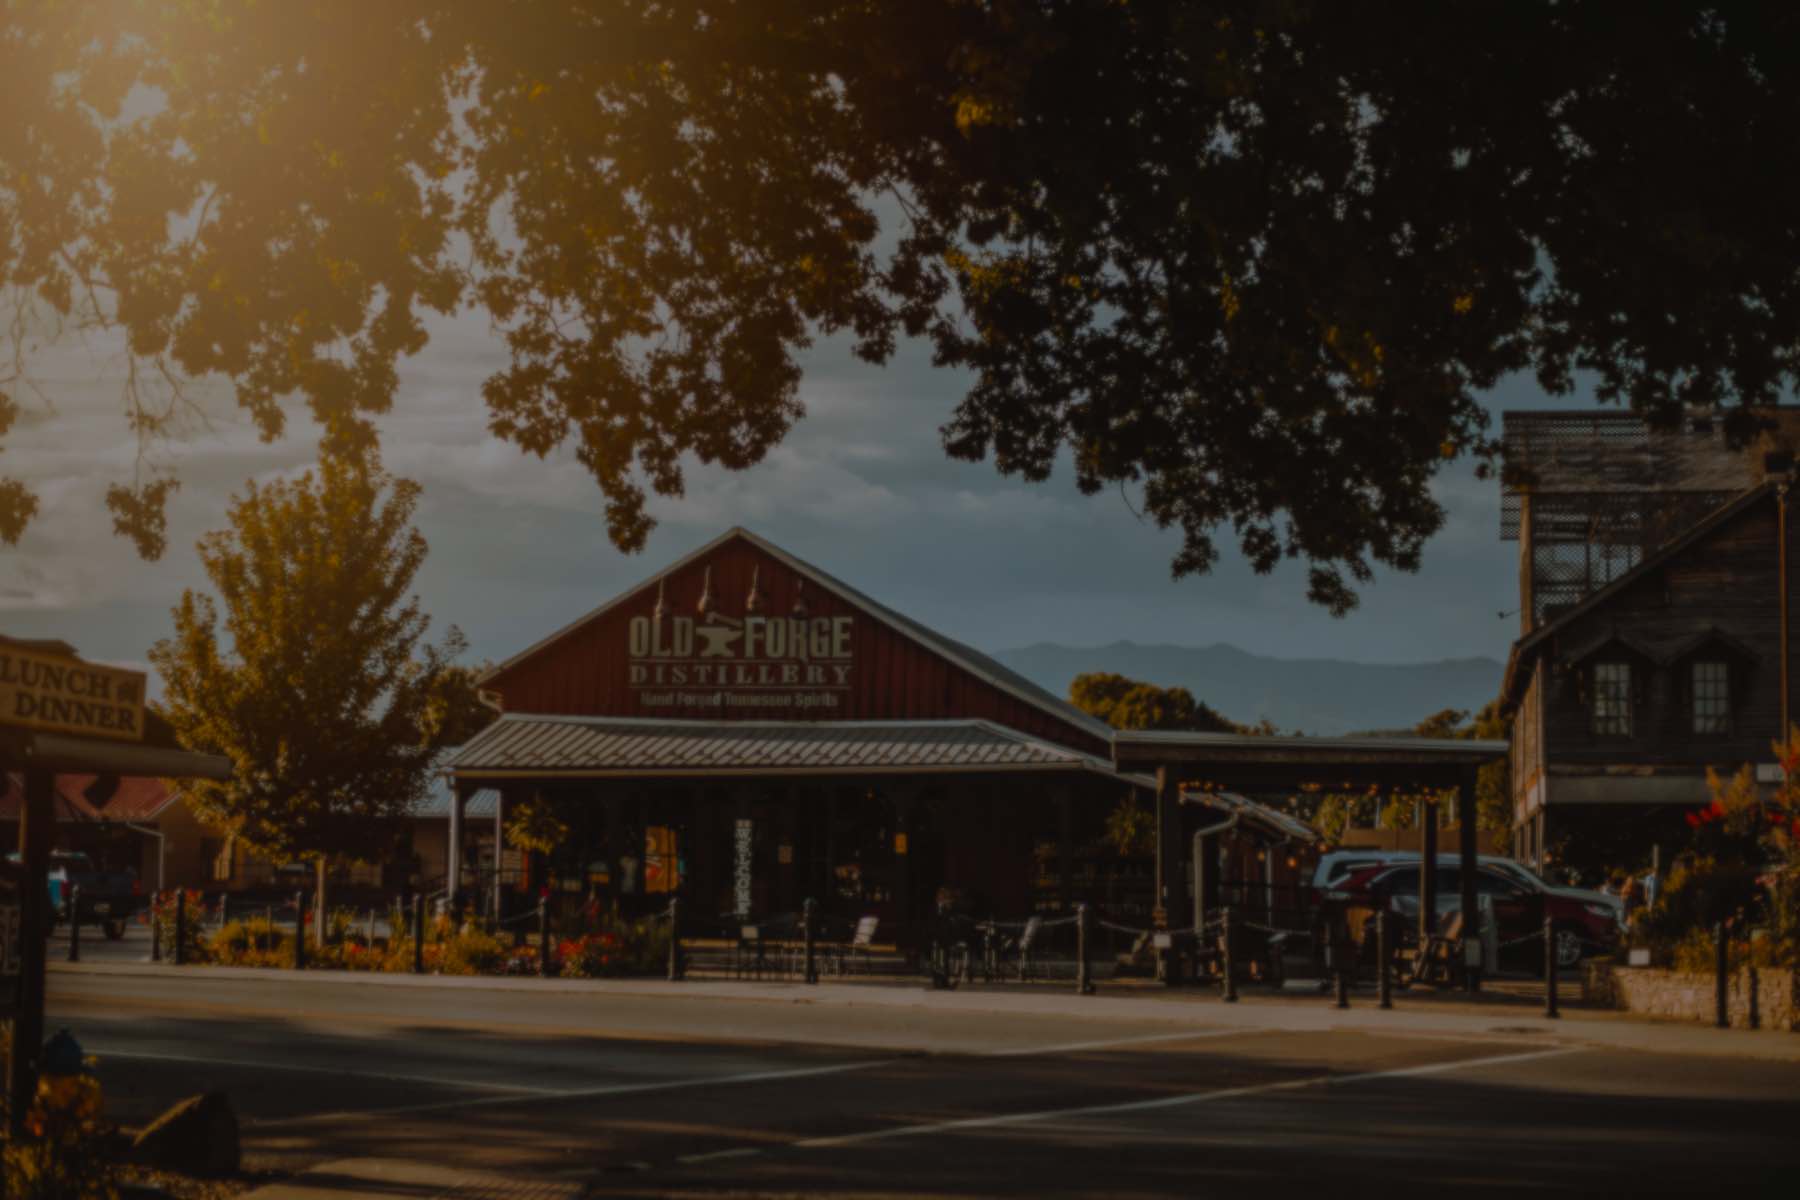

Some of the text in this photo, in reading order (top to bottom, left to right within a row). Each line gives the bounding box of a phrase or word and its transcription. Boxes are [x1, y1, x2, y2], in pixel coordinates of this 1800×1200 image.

[629, 616, 854, 657] OLD FORGE
[0, 656, 112, 699] LUNCH
[630, 664, 852, 684] DISTILLERY
[15, 691, 137, 732] DINNER
